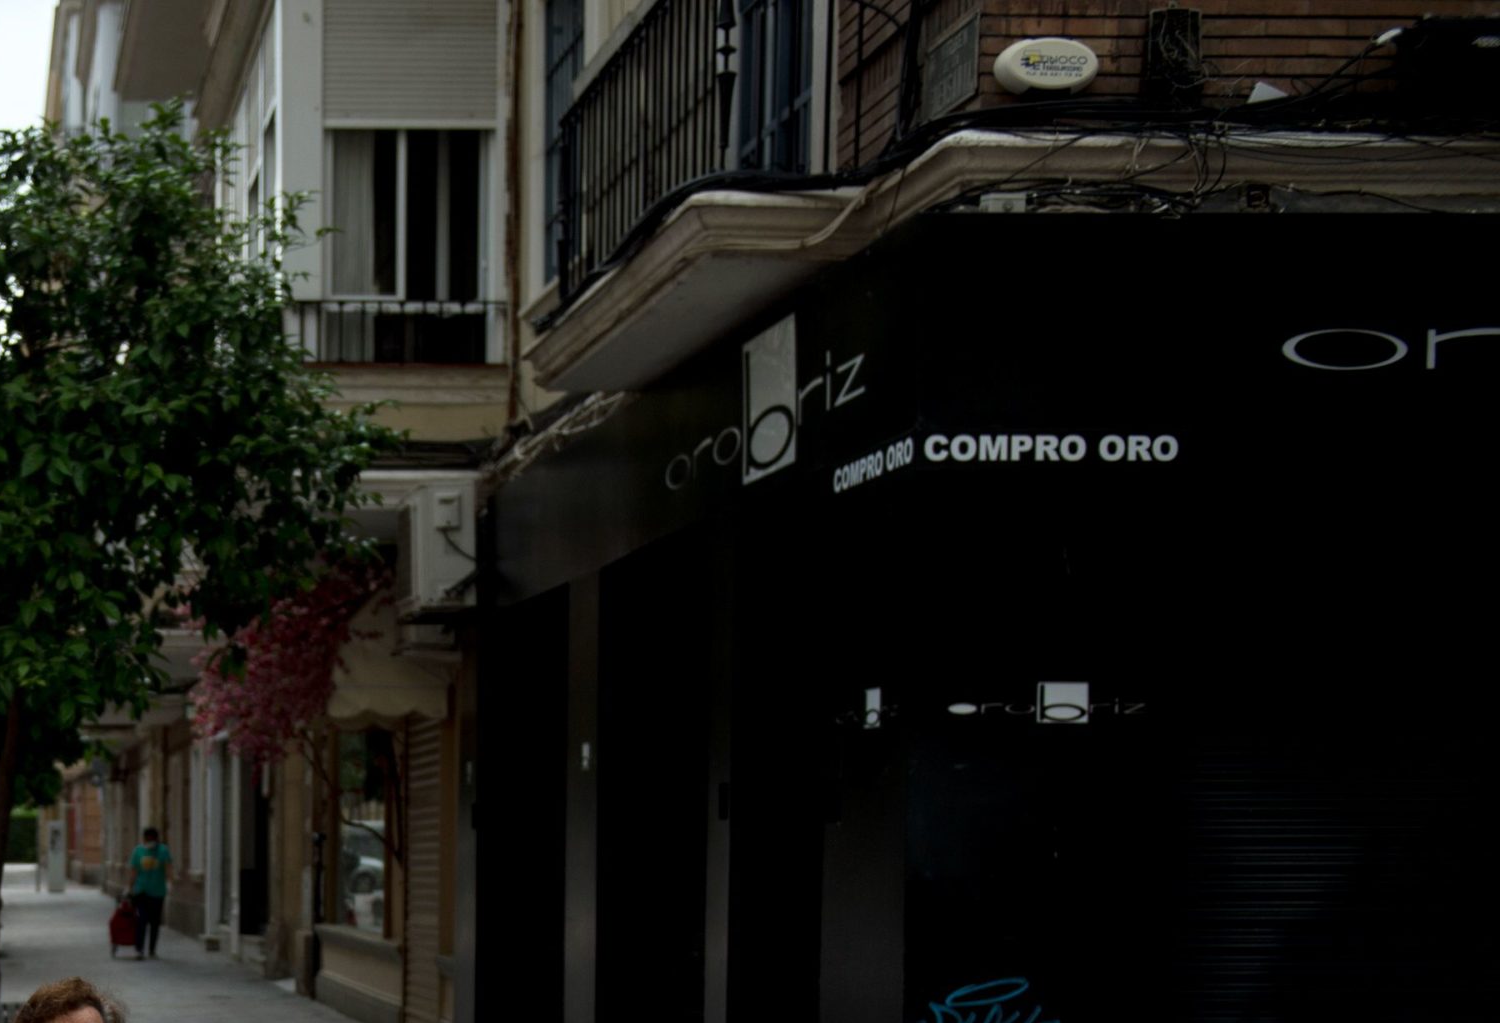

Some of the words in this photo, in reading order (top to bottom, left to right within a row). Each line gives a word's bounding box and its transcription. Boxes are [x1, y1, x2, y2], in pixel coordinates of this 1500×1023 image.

[833, 451, 884, 493] COMPRO
[886, 437, 914, 471] ORO
[924, 435, 1087, 461] COMPRO
[1099, 435, 1178, 461] ORO
